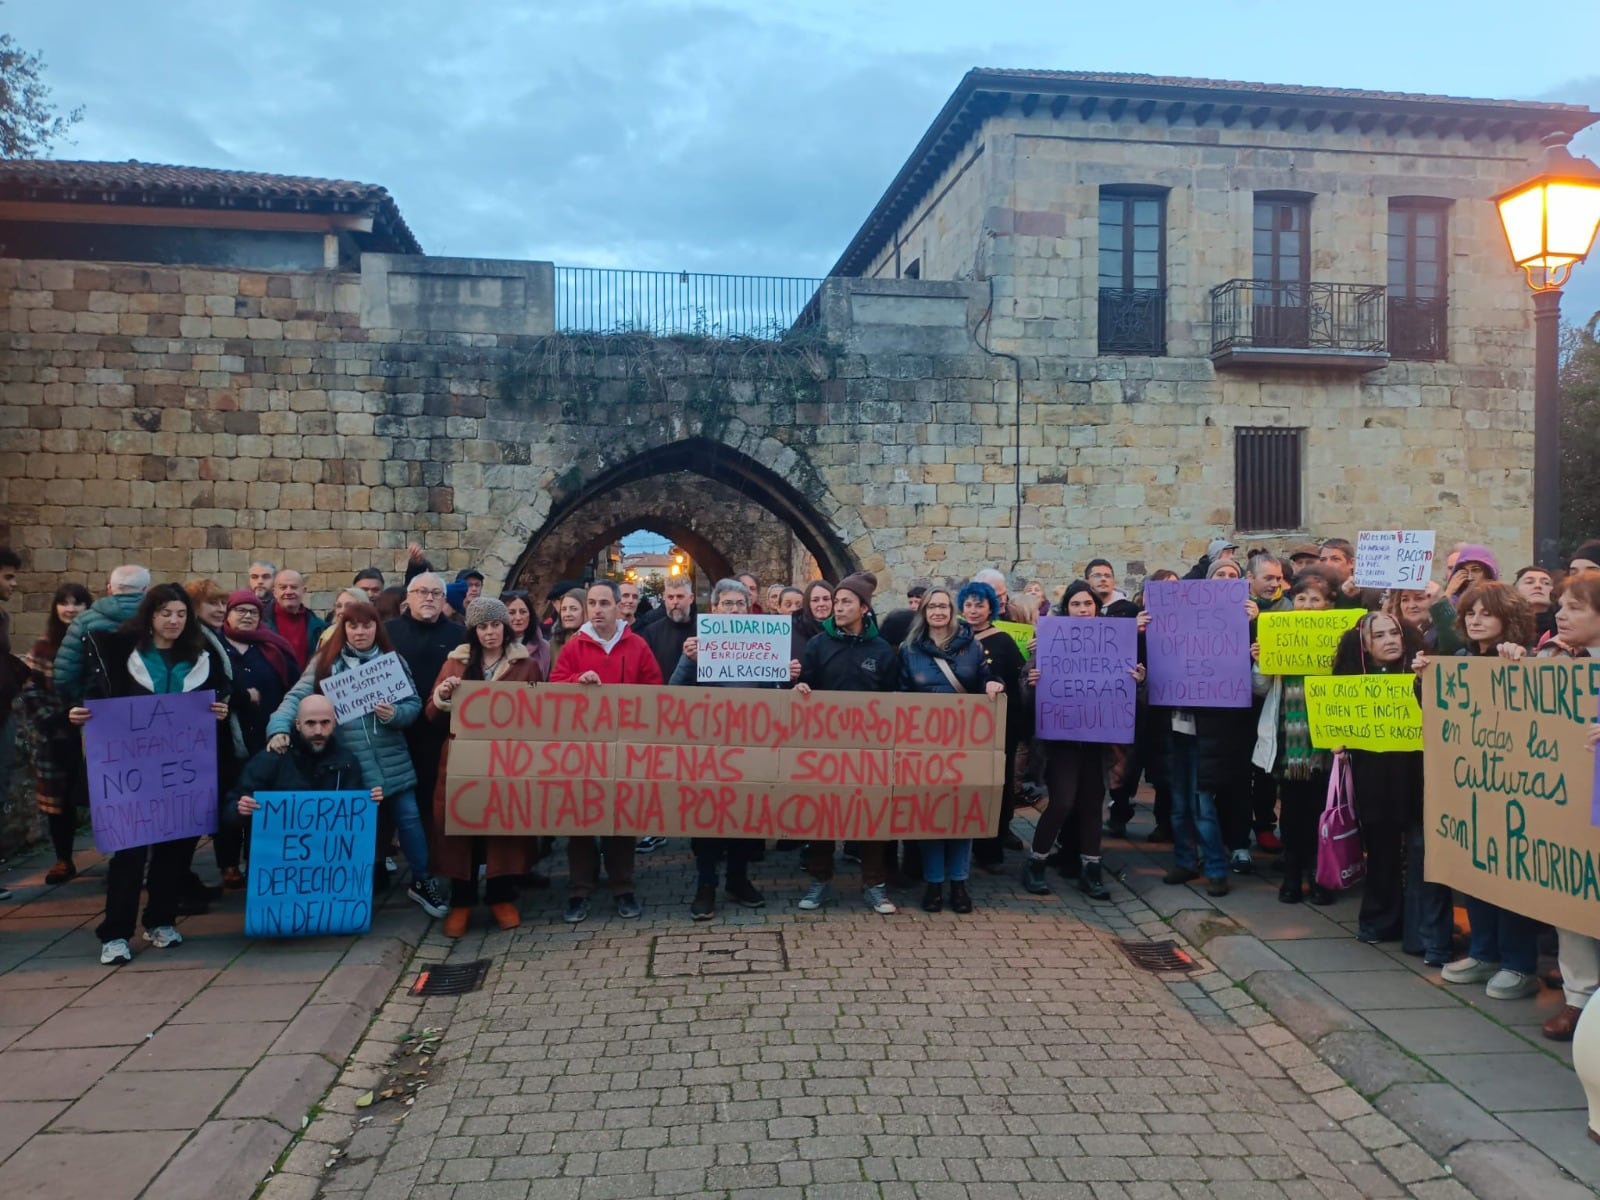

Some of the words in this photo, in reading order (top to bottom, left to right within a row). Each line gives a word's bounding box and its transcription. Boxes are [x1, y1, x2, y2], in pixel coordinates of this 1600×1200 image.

[700, 618, 791, 635] SOLIDARIDAD
[1156, 613, 1179, 632] NO
[1197, 608, 1228, 632] ES
[1268, 616, 1290, 628] SON
[1295, 615, 1349, 629] MENORES
[699, 641, 719, 651] LAS
[721, 641, 772, 651] CULTURAS
[1050, 622, 1119, 653] ABRIR
[711, 651, 779, 661] ENRIQUECEN
[1040, 655, 1136, 674] FRONTERAS
[360, 658, 396, 678] CONTRA
[698, 665, 713, 678] NO
[719, 664, 735, 678] AL
[736, 664, 787, 678] RACISMO
[1185, 659, 1215, 677] ES
[351, 671, 393, 693] SISTEMA
[1050, 678, 1128, 698] CERRAR
[1153, 678, 1250, 701] VIOLENCIA
[1309, 682, 1326, 699] SON
[1364, 684, 1382, 699] NO
[334, 703, 351, 719] NO
[351, 690, 384, 710] CONTRA
[387, 680, 407, 694] LOS
[1316, 702, 1321, 715] Y
[1355, 704, 1368, 718] TE
[1373, 701, 1411, 719] INCITA
[129, 699, 175, 732] LA
[459, 687, 614, 735] CONTRA
[617, 695, 649, 731] EL
[656, 692, 772, 746] RACISMO
[789, 695, 893, 744] DISCURSO
[894, 704, 925, 744] DE
[924, 698, 995, 748] ODIO
[1040, 701, 1135, 731] PREJUICIOS
[1316, 724, 1321, 738] A
[1323, 724, 1371, 738] TEMERLOS
[1374, 724, 1386, 738] ES
[1442, 719, 1462, 744] en
[1470, 701, 1514, 752] todas
[1526, 720, 1559, 762] las
[102, 725, 209, 764] INFANCIA
[488, 738, 534, 778] NO
[537, 740, 608, 778] SON
[625, 744, 745, 783] MENAS
[790, 749, 865, 786] SON
[866, 749, 968, 787] NIÑOS
[103, 768, 143, 799] NO
[161, 759, 198, 789] ES
[262, 793, 368, 832] MIGRAR
[450, 778, 666, 833] CANTABRIA
[677, 784, 739, 835] POR
[742, 792, 775, 837] LA
[775, 786, 988, 839] CONVIVENCIA
[282, 834, 312, 861] ES
[323, 834, 355, 864] UN
[1506, 799, 1600, 902] PRIORIDA
